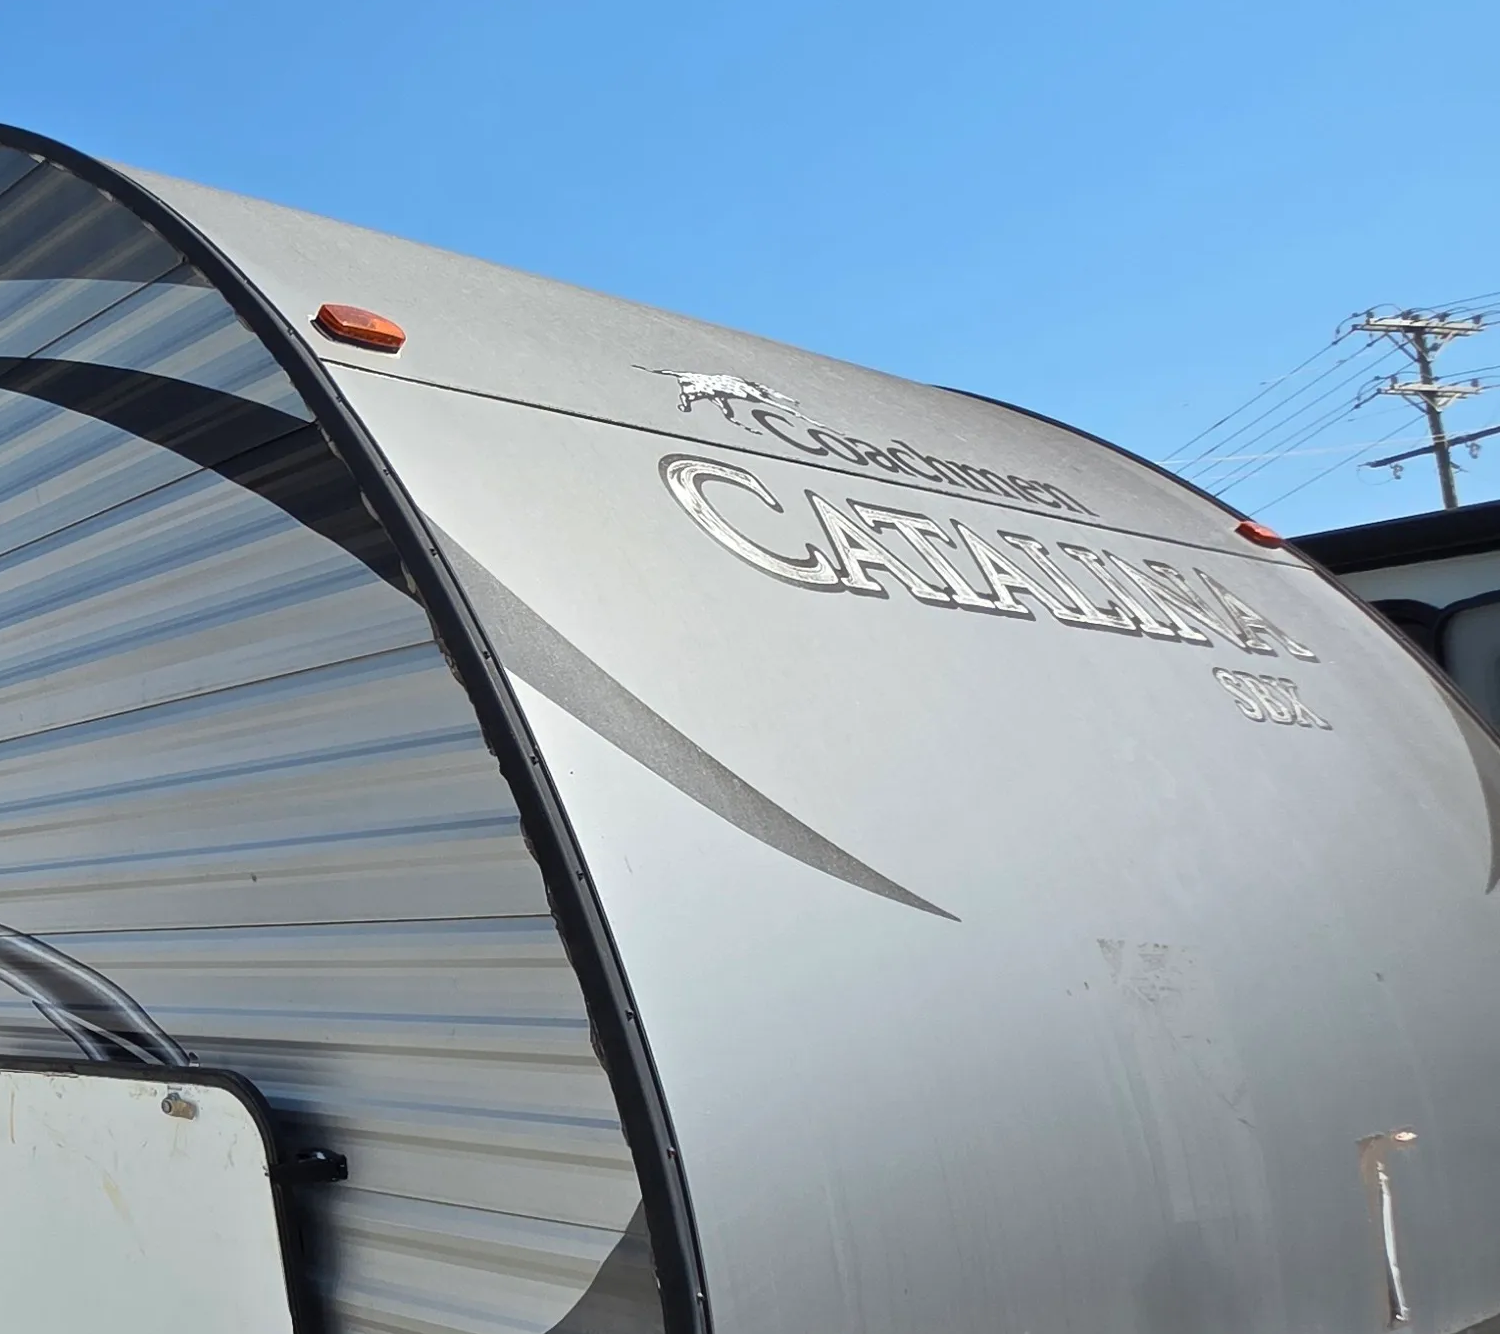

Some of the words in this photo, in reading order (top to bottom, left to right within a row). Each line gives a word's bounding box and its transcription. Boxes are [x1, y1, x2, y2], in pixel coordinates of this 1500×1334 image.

[752, 409, 1100, 517] Coachmen
[658, 453, 1321, 663] CATALINA
[1212, 667, 1333, 730] SBX
